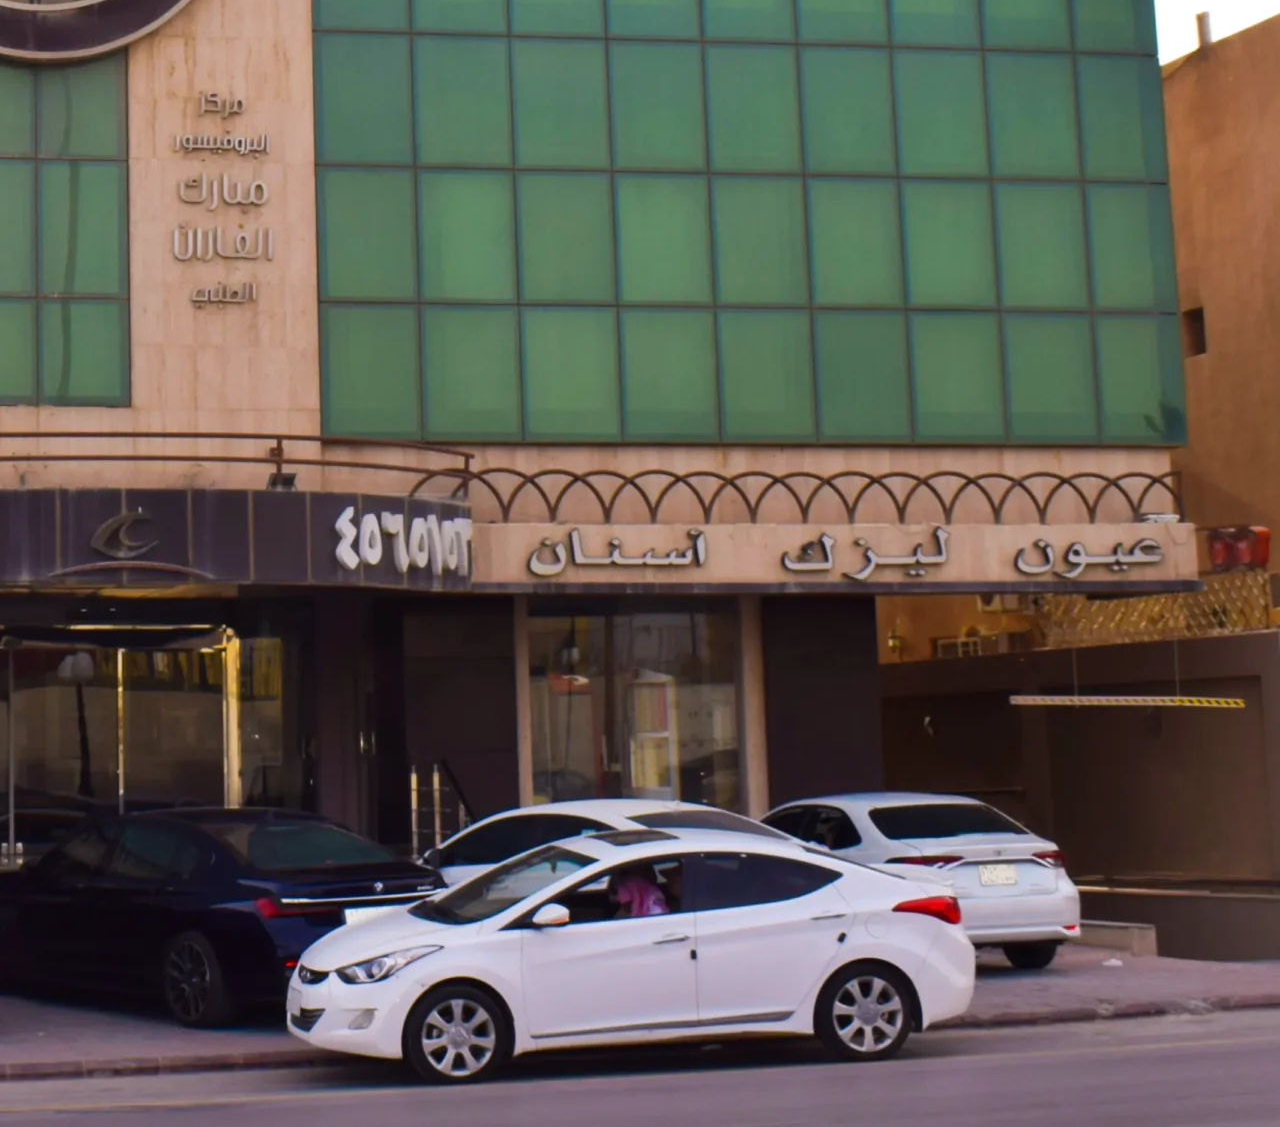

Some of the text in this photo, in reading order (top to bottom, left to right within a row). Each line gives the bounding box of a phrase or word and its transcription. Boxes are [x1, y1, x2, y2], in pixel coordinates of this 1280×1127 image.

[198, 90, 245, 119] مركز
[178, 173, 269, 214] مبارك
[173, 222, 275, 261] الفاران
[191, 281, 257, 309] الطبي
[527, 526, 1164, 581] عيون ليزك أسنان
